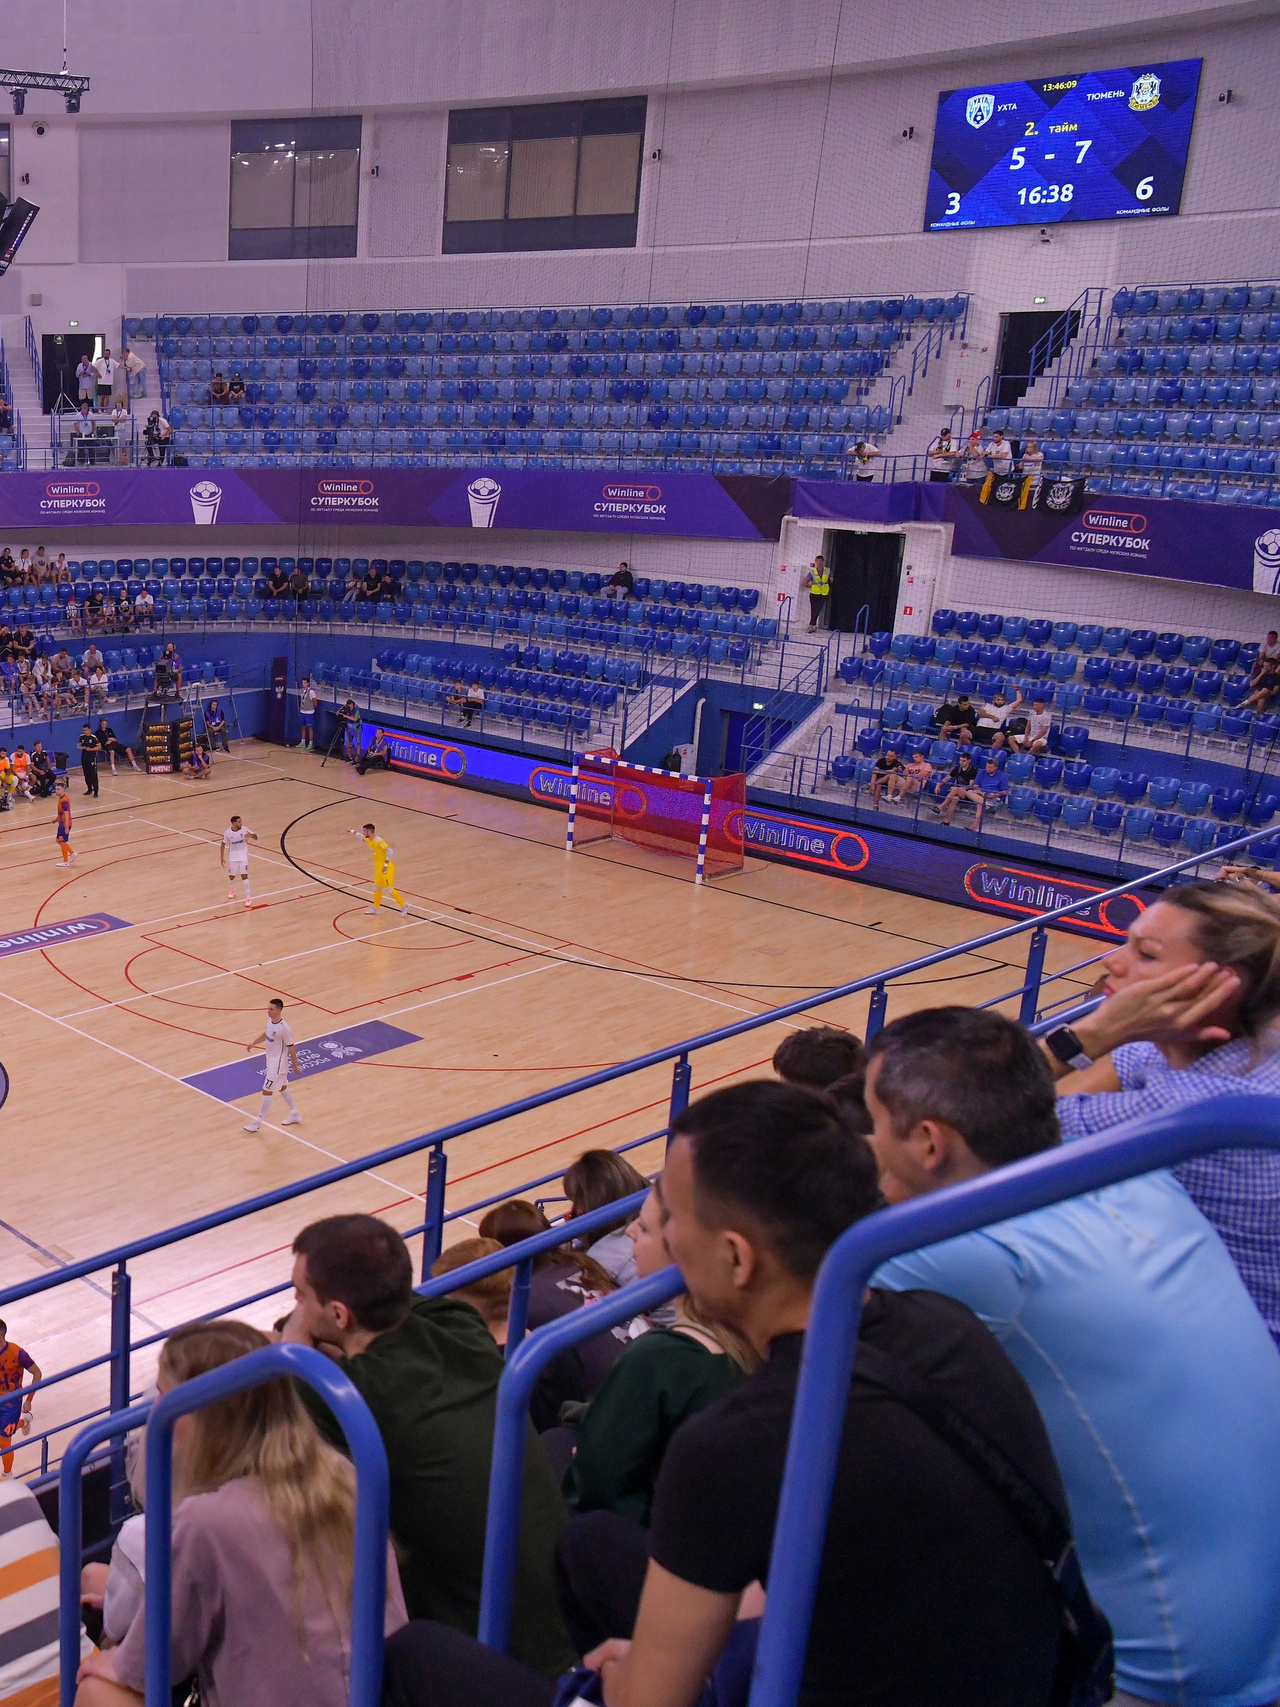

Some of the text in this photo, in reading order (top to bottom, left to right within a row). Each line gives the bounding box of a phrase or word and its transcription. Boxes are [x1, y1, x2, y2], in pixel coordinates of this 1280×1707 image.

[1043, 80, 1077, 91] 13:46:09
[1086, 90, 1125, 101] ТЮМЕНЬ
[998, 103, 1017, 112] УХТА
[1025, 122, 1078, 136] 2. тайм
[1010, 147, 1026, 170] 5
[1076, 140, 1093, 164] 7
[1018, 184, 1074, 205] 16:38
[1136, 177, 1154, 200] 6
[946, 192, 961, 215] 3
[51, 486, 85, 494] Winline
[323, 483, 358, 491] Winline
[608, 488, 644, 497] Winline
[40, 499, 106, 508] СУПЕРКУБОК
[310, 497, 379, 506] СУПЕРКУБОК
[594, 502, 667, 514] СУПЕРКУБОК
[1089, 515, 1128, 528] Winline
[1072, 532, 1151, 550] СУПЕРКУБОК
[390, 741, 437, 766] inline
[738, 818, 825, 854] Winline
